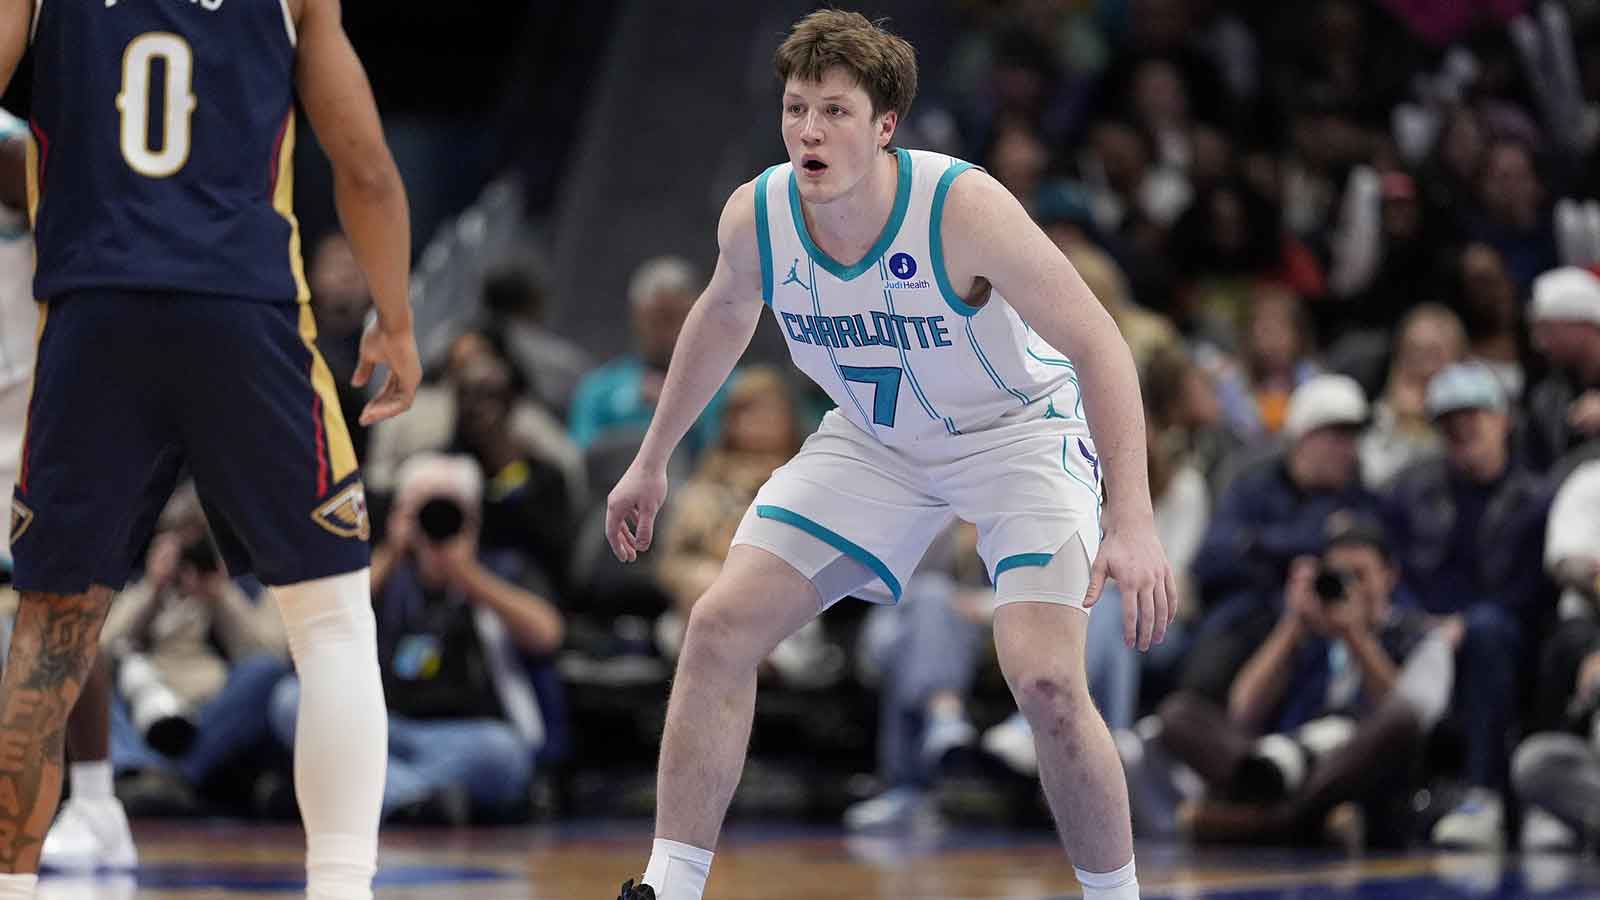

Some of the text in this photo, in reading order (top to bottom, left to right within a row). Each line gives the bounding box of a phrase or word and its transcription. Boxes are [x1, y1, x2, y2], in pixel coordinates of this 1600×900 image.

[116, 32, 197, 178] 0
[780, 311, 953, 350] CHARLOTTE
[839, 365, 903, 428] 7
